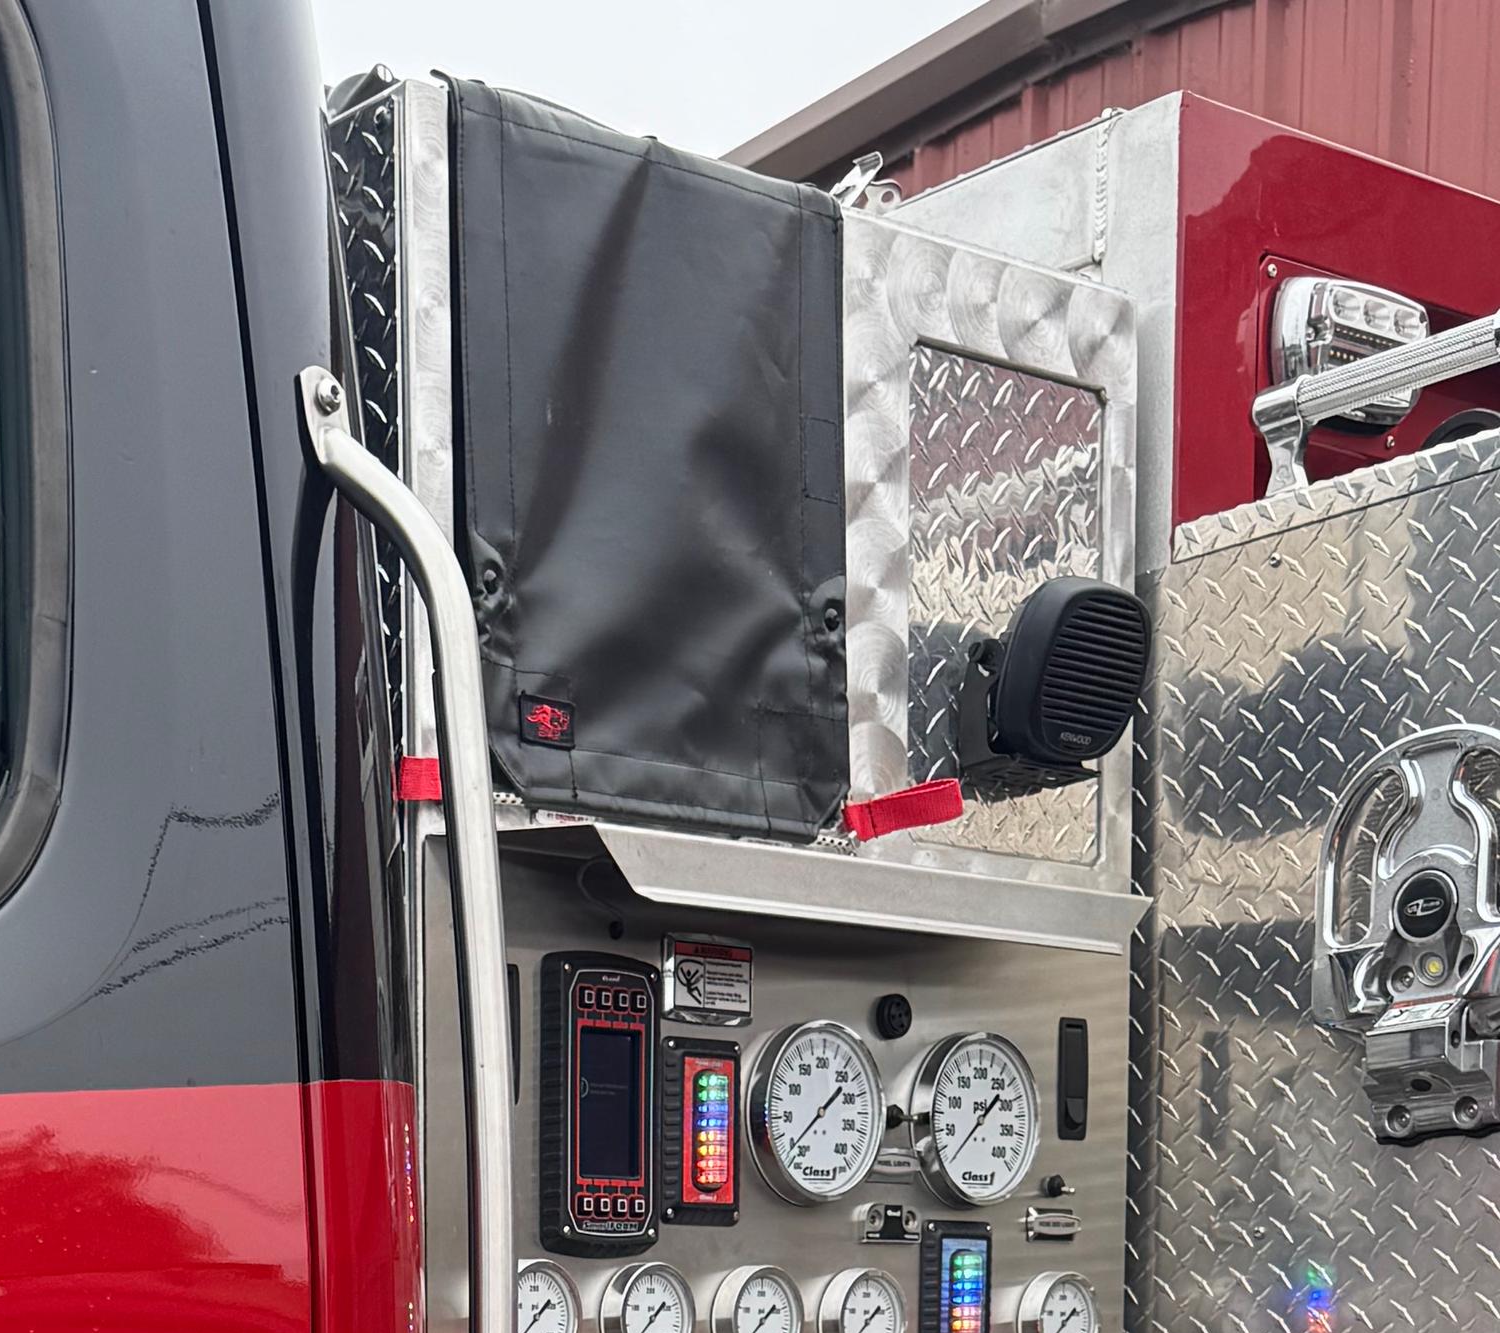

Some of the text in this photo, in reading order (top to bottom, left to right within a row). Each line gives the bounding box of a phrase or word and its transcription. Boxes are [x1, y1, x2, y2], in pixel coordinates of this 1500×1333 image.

[816, 1057, 829, 1069] 200
[798, 1064, 811, 1076] 150
[973, 1067, 987, 1080] 200
[835, 1071, 848, 1083] 250
[957, 1076, 970, 1089] 150
[789, 1083, 800, 1096] 100
[991, 1078, 1005, 1090] 250
[948, 1096, 961, 1109] 100
[973, 1099, 987, 1114] psi
[999, 1099, 1013, 1111] 300
[783, 1111, 793, 1123] 50
[842, 1119, 855, 1131] 350
[946, 1124, 955, 1136] 50
[999, 1124, 1013, 1136] 350
[834, 1143, 847, 1155] 400
[991, 1146, 1006, 1159] 400
